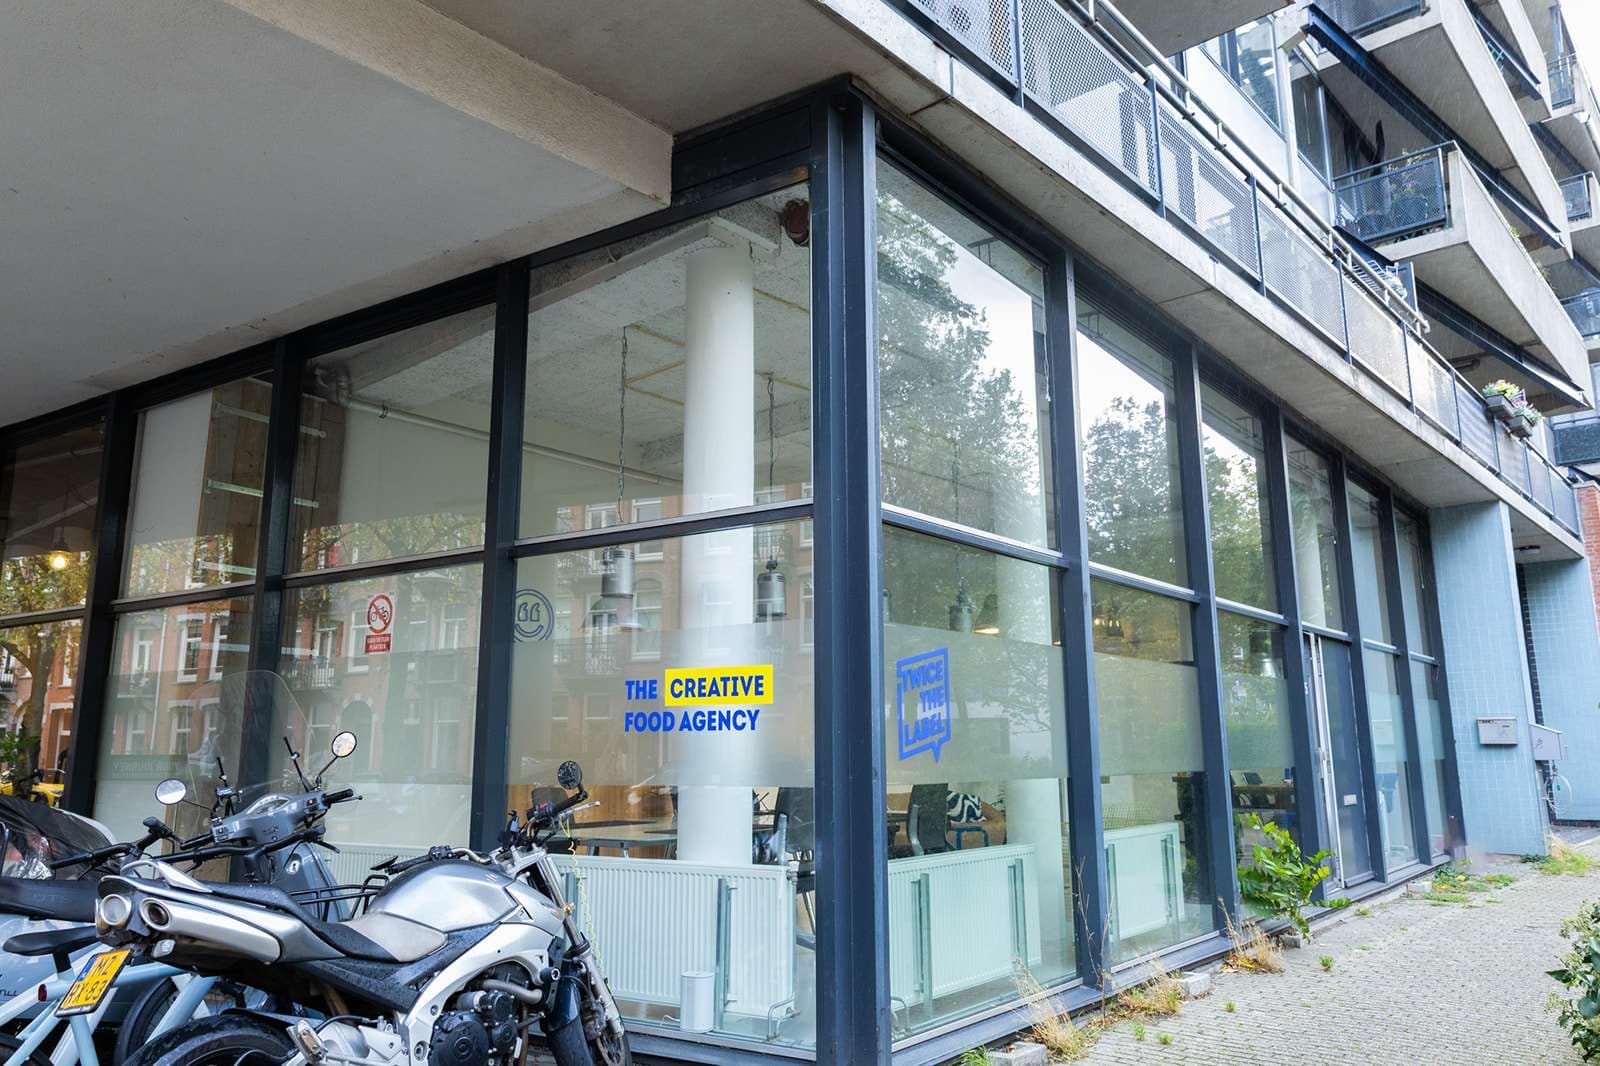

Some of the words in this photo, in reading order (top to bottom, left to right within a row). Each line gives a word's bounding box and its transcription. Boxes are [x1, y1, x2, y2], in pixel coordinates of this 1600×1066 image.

[624, 680, 658, 700] THE
[670, 675, 765, 698] CREATIVE
[902, 658, 944, 693] TWICE
[920, 685, 944, 713] THE
[624, 711, 675, 733] FOOD
[679, 709, 760, 731] AGENCY
[905, 711, 945, 747] LABEL
